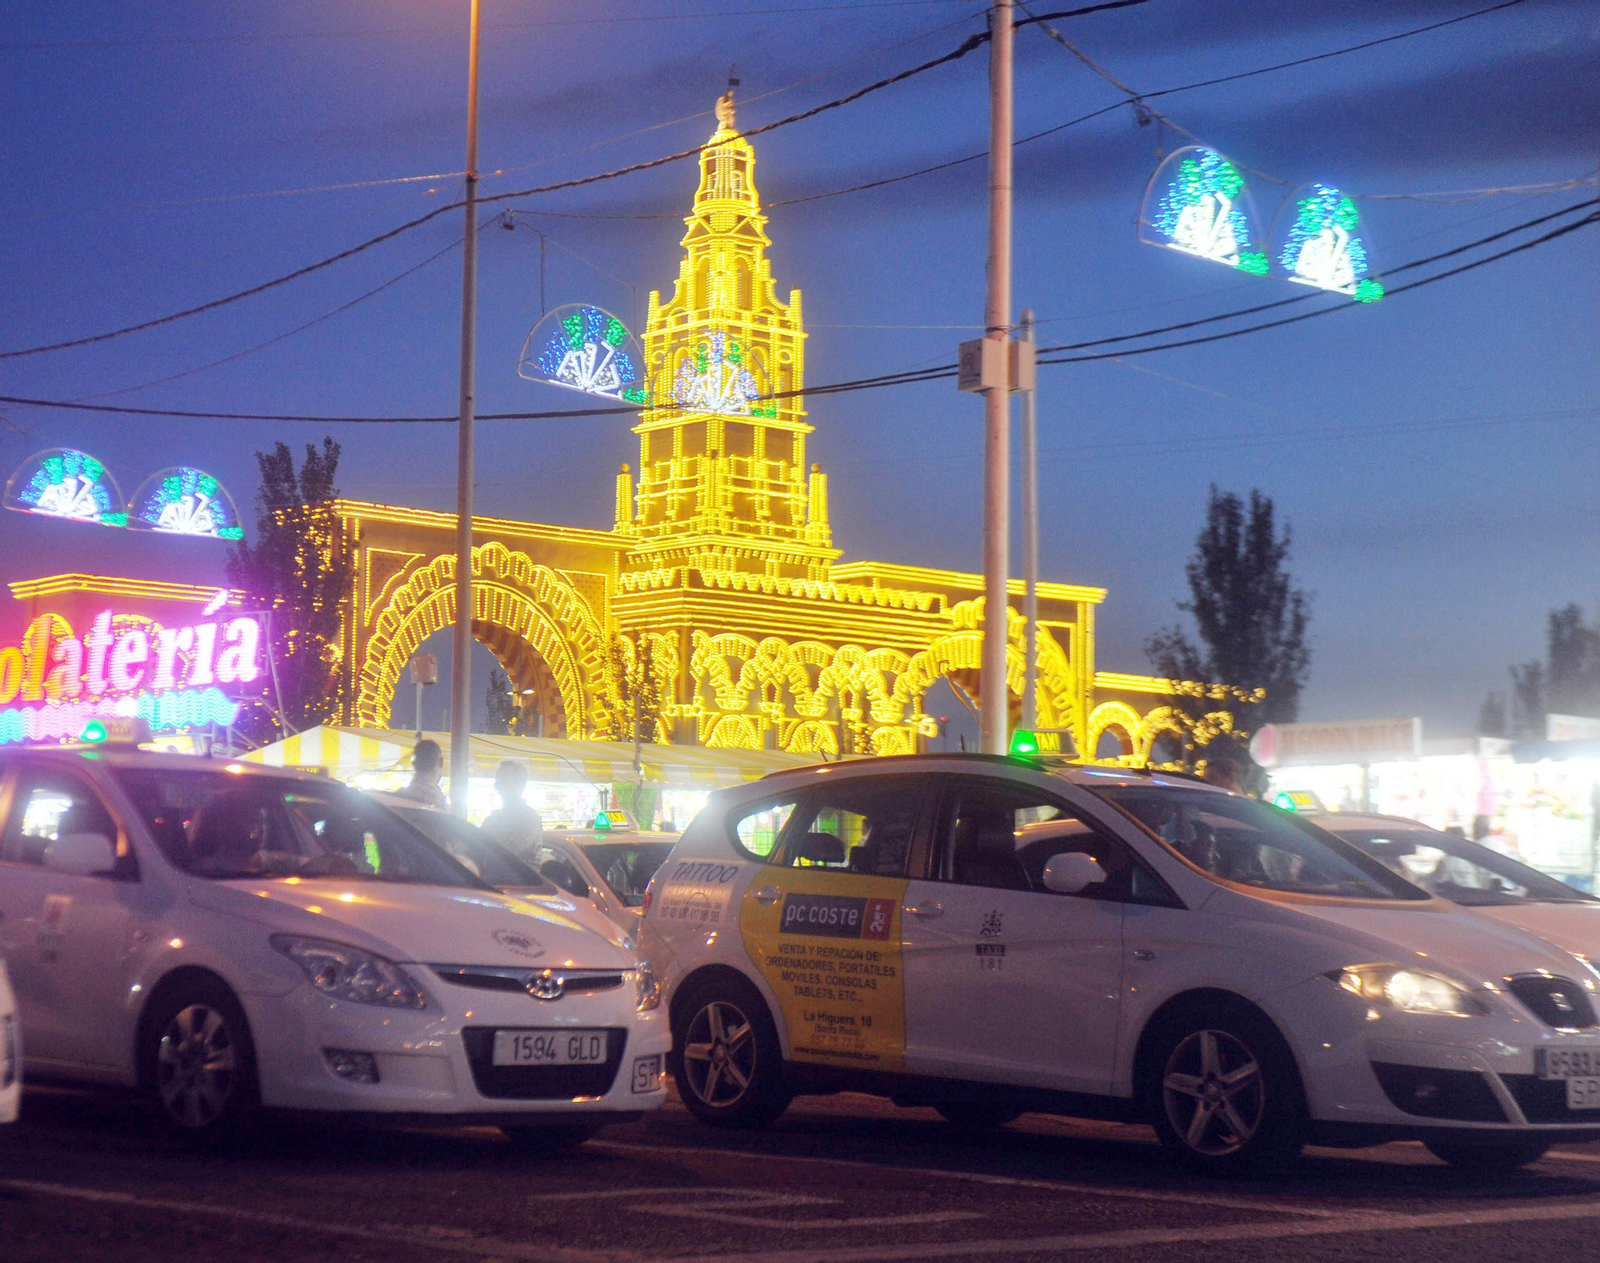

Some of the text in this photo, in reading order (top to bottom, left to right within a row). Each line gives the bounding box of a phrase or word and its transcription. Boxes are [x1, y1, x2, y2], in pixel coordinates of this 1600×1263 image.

[1034, 732, 1060, 750] TAXI
[606, 812, 626, 822] TAXI
[671, 861, 738, 883] TATTOO
[778, 943, 806, 955] VENTA
[809, 946, 815, 956] Y
[979, 944, 1001, 956] TAXI
[765, 956, 896, 977] ORDENADORES, PORTATILES
[825, 975, 877, 990] CONSOLAS
[794, 985, 836, 1001] TABLETS,
[803, 1009, 872, 1027] La Higuera, 10
[513, 1036, 600, 1061] 1594 GLD
[638, 1063, 656, 1088] SP
